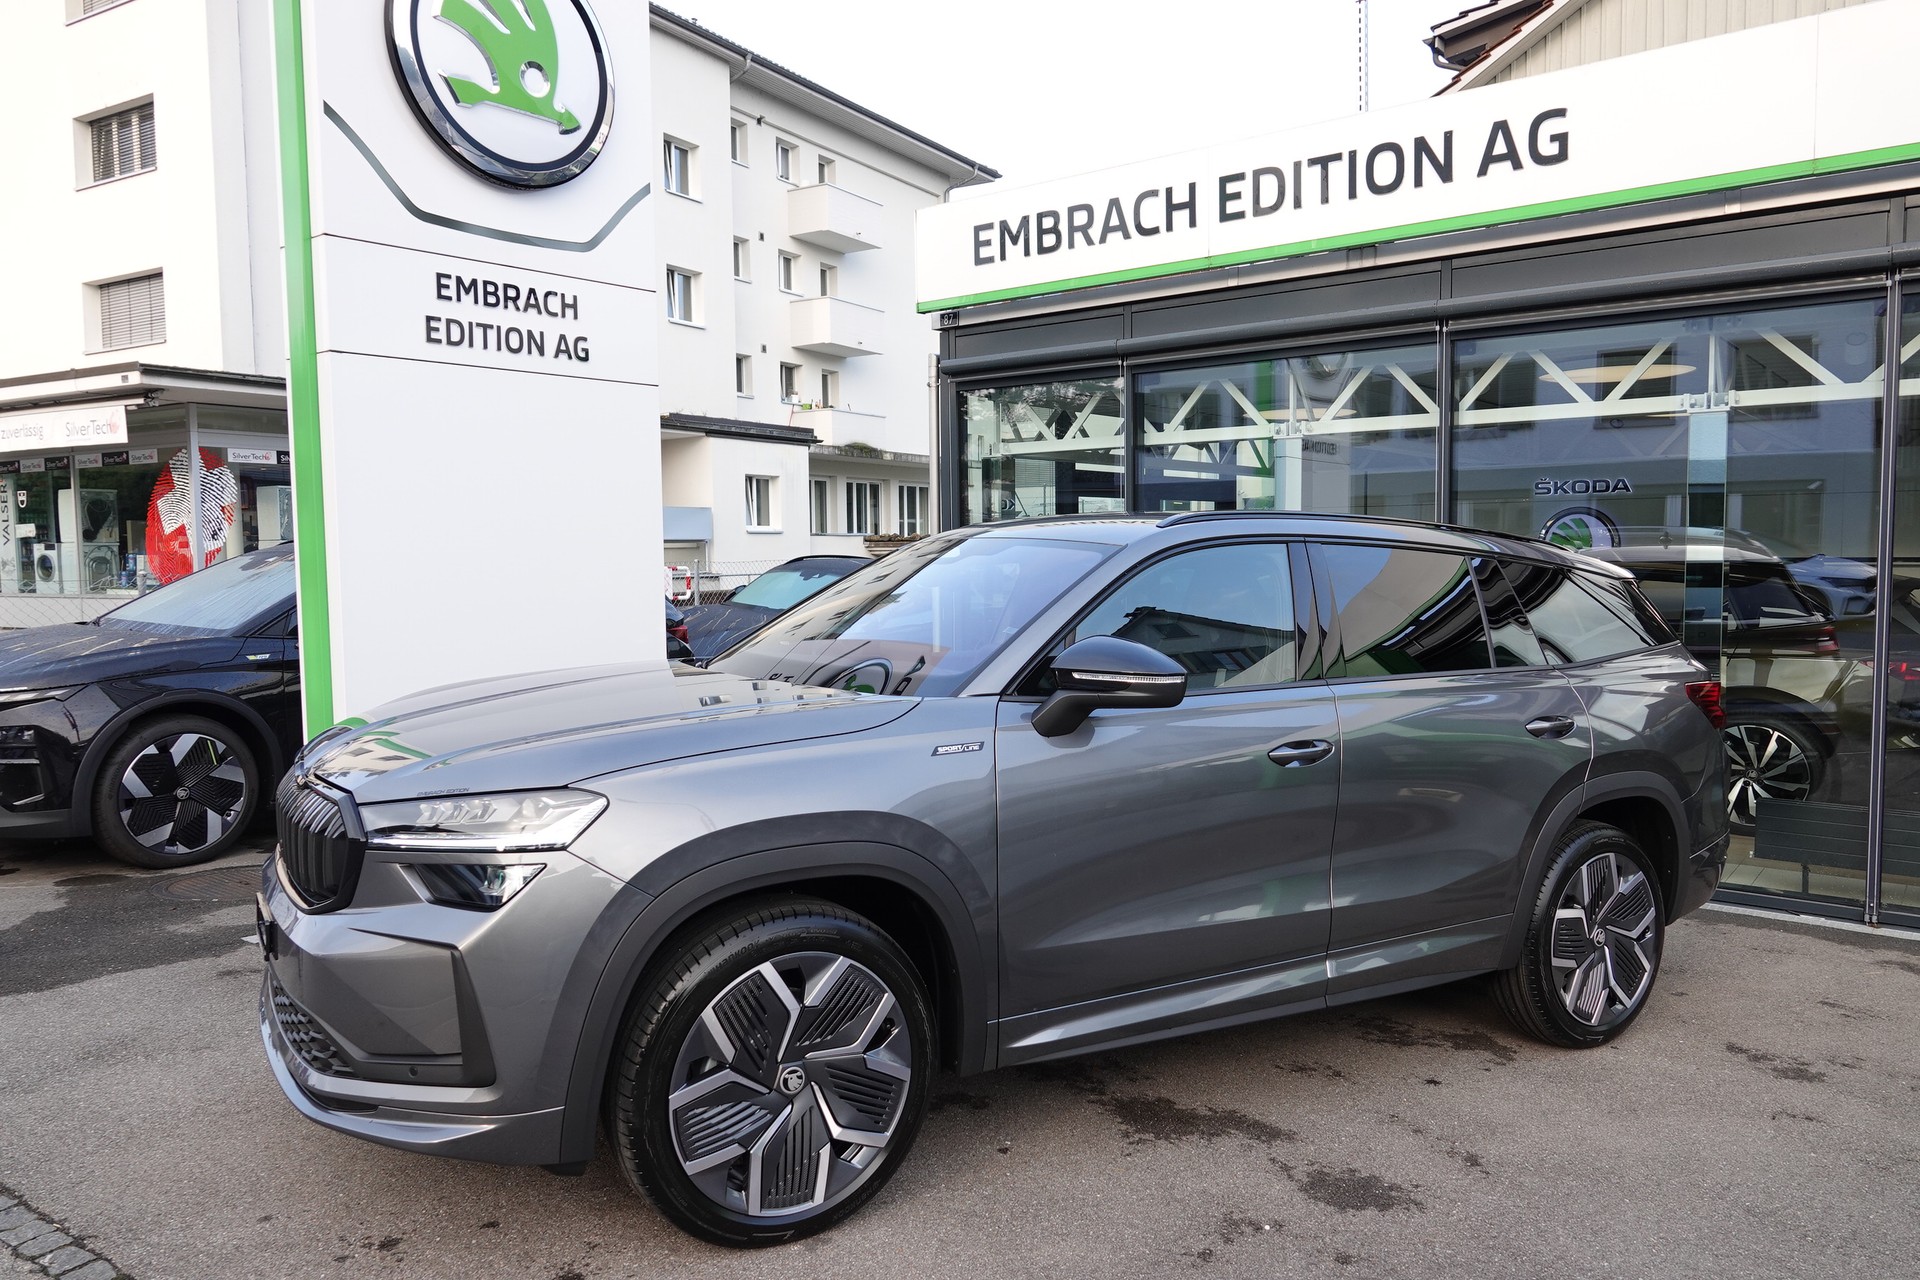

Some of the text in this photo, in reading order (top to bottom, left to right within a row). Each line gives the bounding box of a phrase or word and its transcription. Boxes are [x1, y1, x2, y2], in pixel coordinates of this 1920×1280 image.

[973, 107, 1570, 267] EMBRACH EDITION AG
[436, 272, 578, 320] EMBRACH
[943, 314, 954, 326] 87
[425, 314, 590, 363] EDITION AG
[1534, 477, 1632, 496] ŠKODA
[1, 483, 10, 546] VALSER
